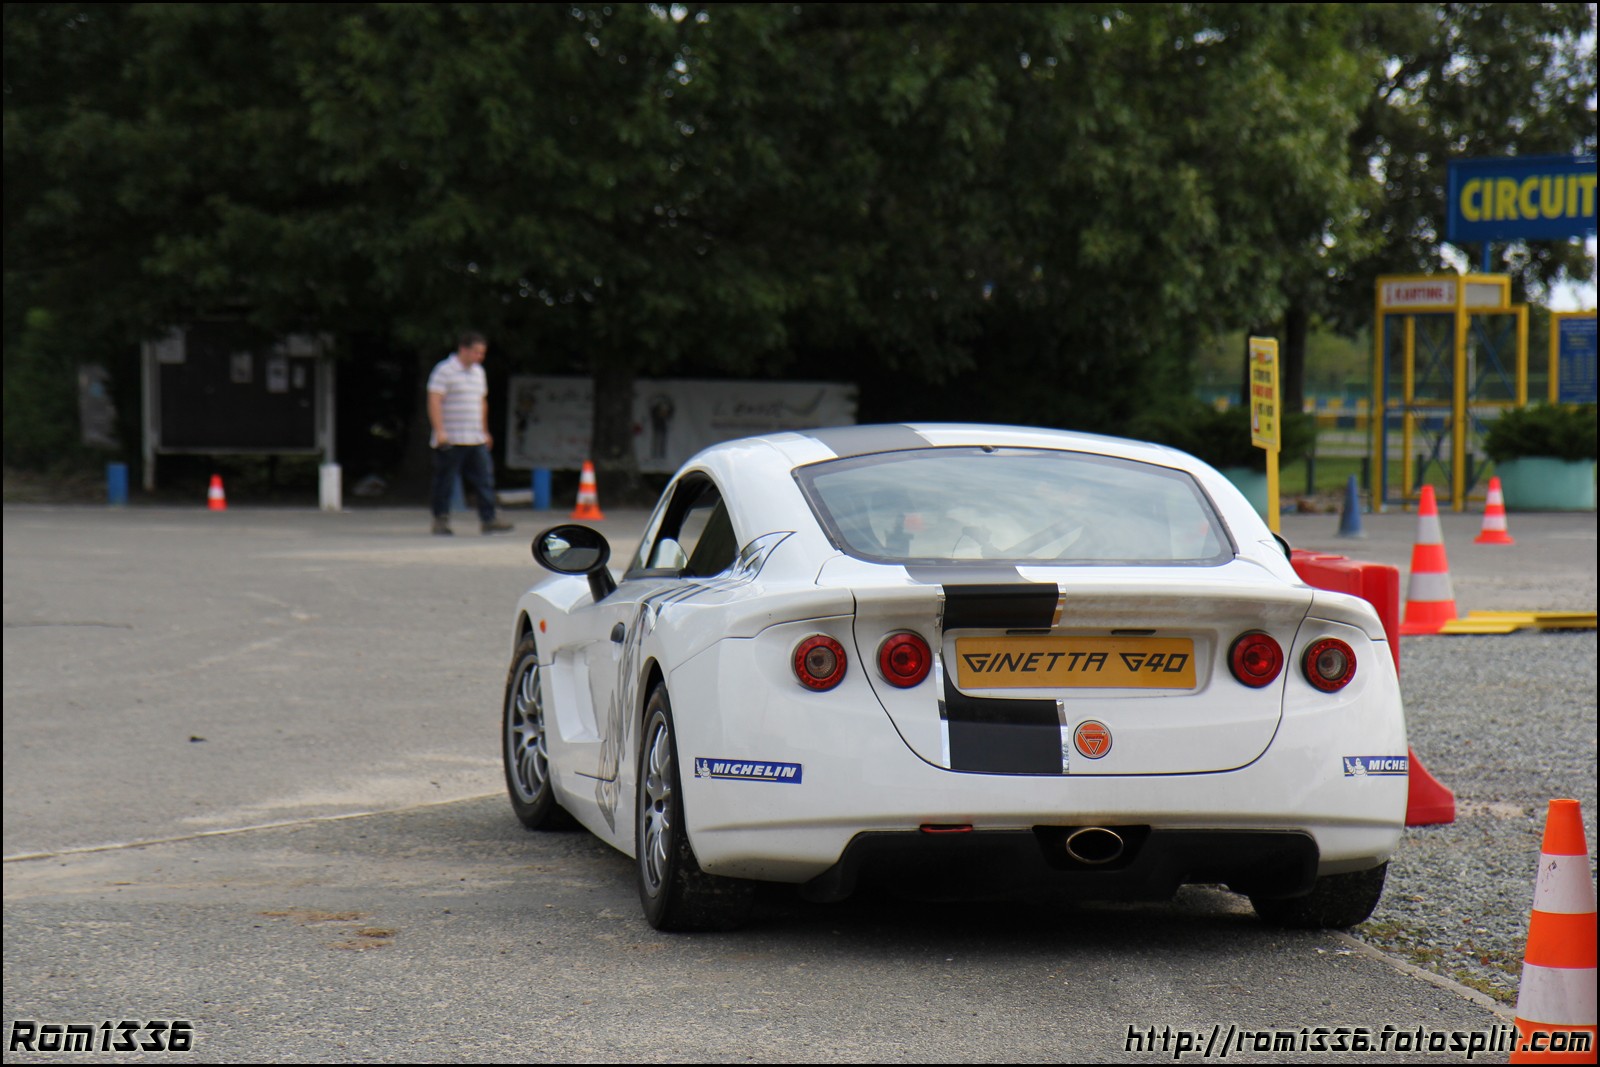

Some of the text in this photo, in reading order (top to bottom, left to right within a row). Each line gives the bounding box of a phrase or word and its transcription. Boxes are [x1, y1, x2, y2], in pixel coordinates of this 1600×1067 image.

[1460, 174, 1597, 222] CIRCUIT
[962, 652, 1189, 673] GINETTA G40
[712, 762, 797, 778] MICHELIN
